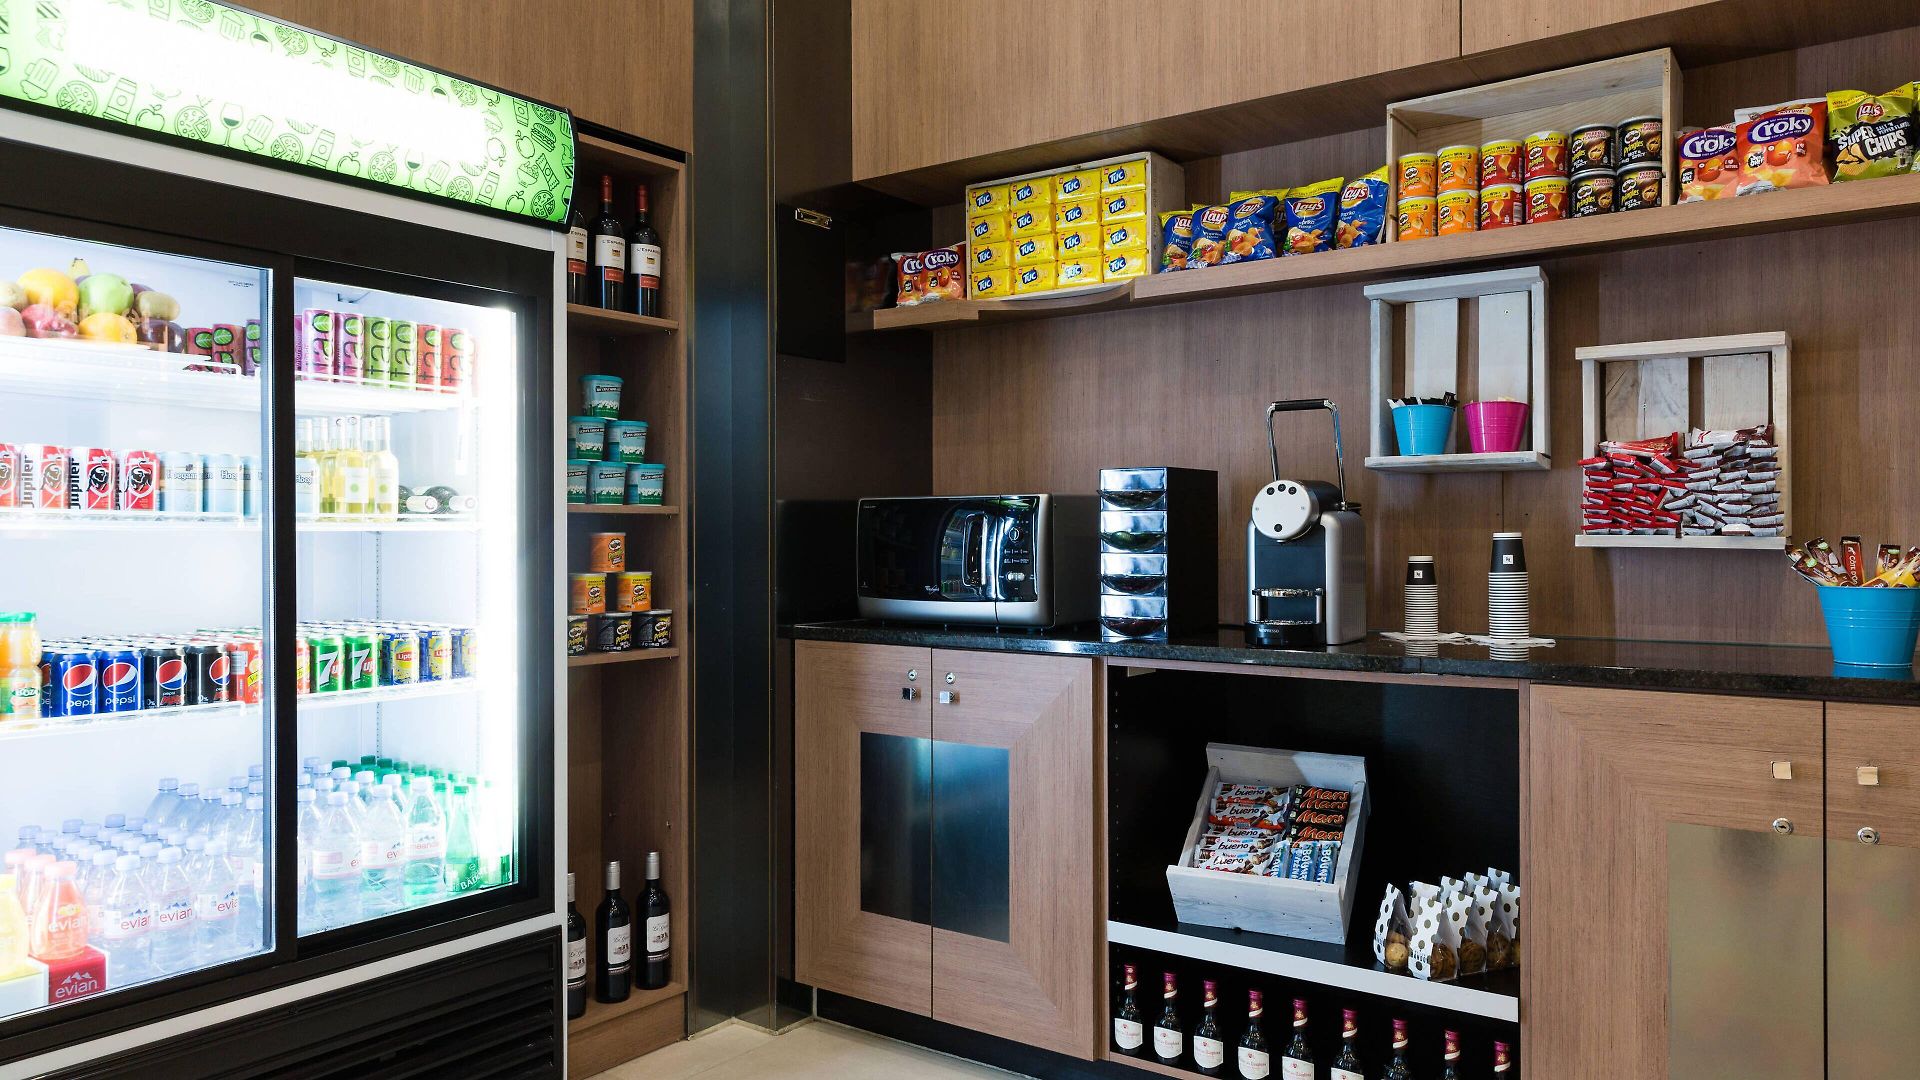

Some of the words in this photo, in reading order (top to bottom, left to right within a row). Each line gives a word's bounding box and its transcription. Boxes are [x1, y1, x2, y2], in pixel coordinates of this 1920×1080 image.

[1752, 117, 1811, 141] Croky
[1838, 126, 1877, 151] SUPER
[1865, 129, 1907, 156] CHIPS
[1341, 186, 1368, 202] Lay's
[1295, 201, 1323, 213] Lay's
[903, 258, 924, 274] Cro
[925, 252, 959, 269] Croky
[21, 454, 37, 508] Jupiler
[71, 457, 84, 509] Jupiler
[67, 698, 95, 709] peps
[105, 695, 136, 705] pepsi
[1235, 788, 1264, 796] bueno
[1303, 786, 1349, 801] Mars
[1230, 806, 1259, 815] bueno
[1299, 797, 1348, 809] Mars
[1296, 809, 1344, 824] Mars
[1228, 828, 1258, 836] bueno
[1298, 825, 1344, 841] Mars
[1218, 842, 1249, 850] bueno
[217, 898, 237, 912] evi
[159, 907, 193, 923] evian
[56, 979, 98, 998] evian
